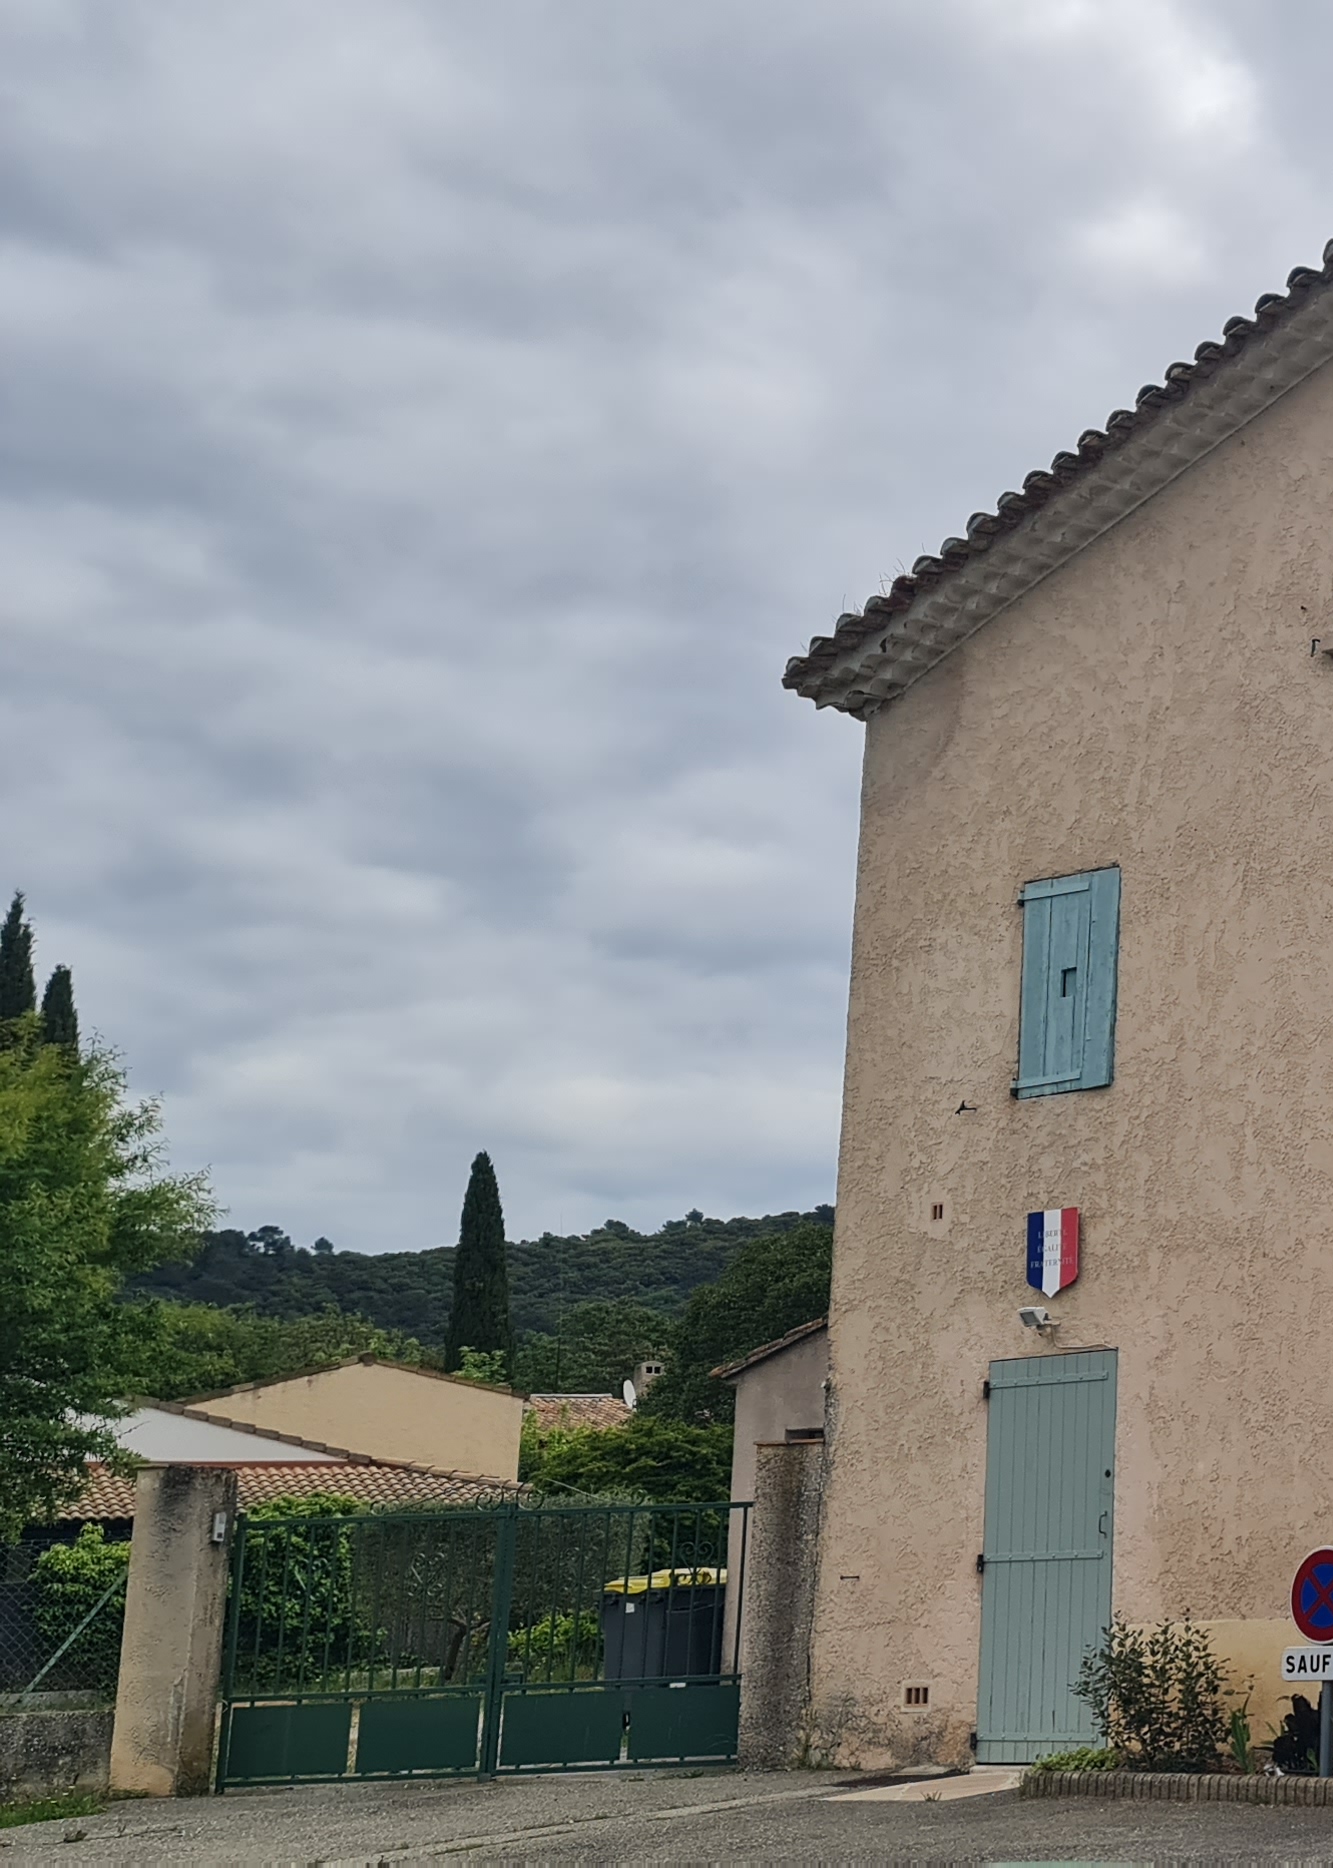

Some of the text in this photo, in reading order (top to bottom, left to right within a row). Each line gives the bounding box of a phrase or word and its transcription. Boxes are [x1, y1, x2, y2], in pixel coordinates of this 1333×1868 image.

[1037, 1229, 1067, 1239] LBERÉ
[1036, 1243, 1066, 1253] ÉGALIÉ
[1286, 1654, 1331, 1673] SAUF
